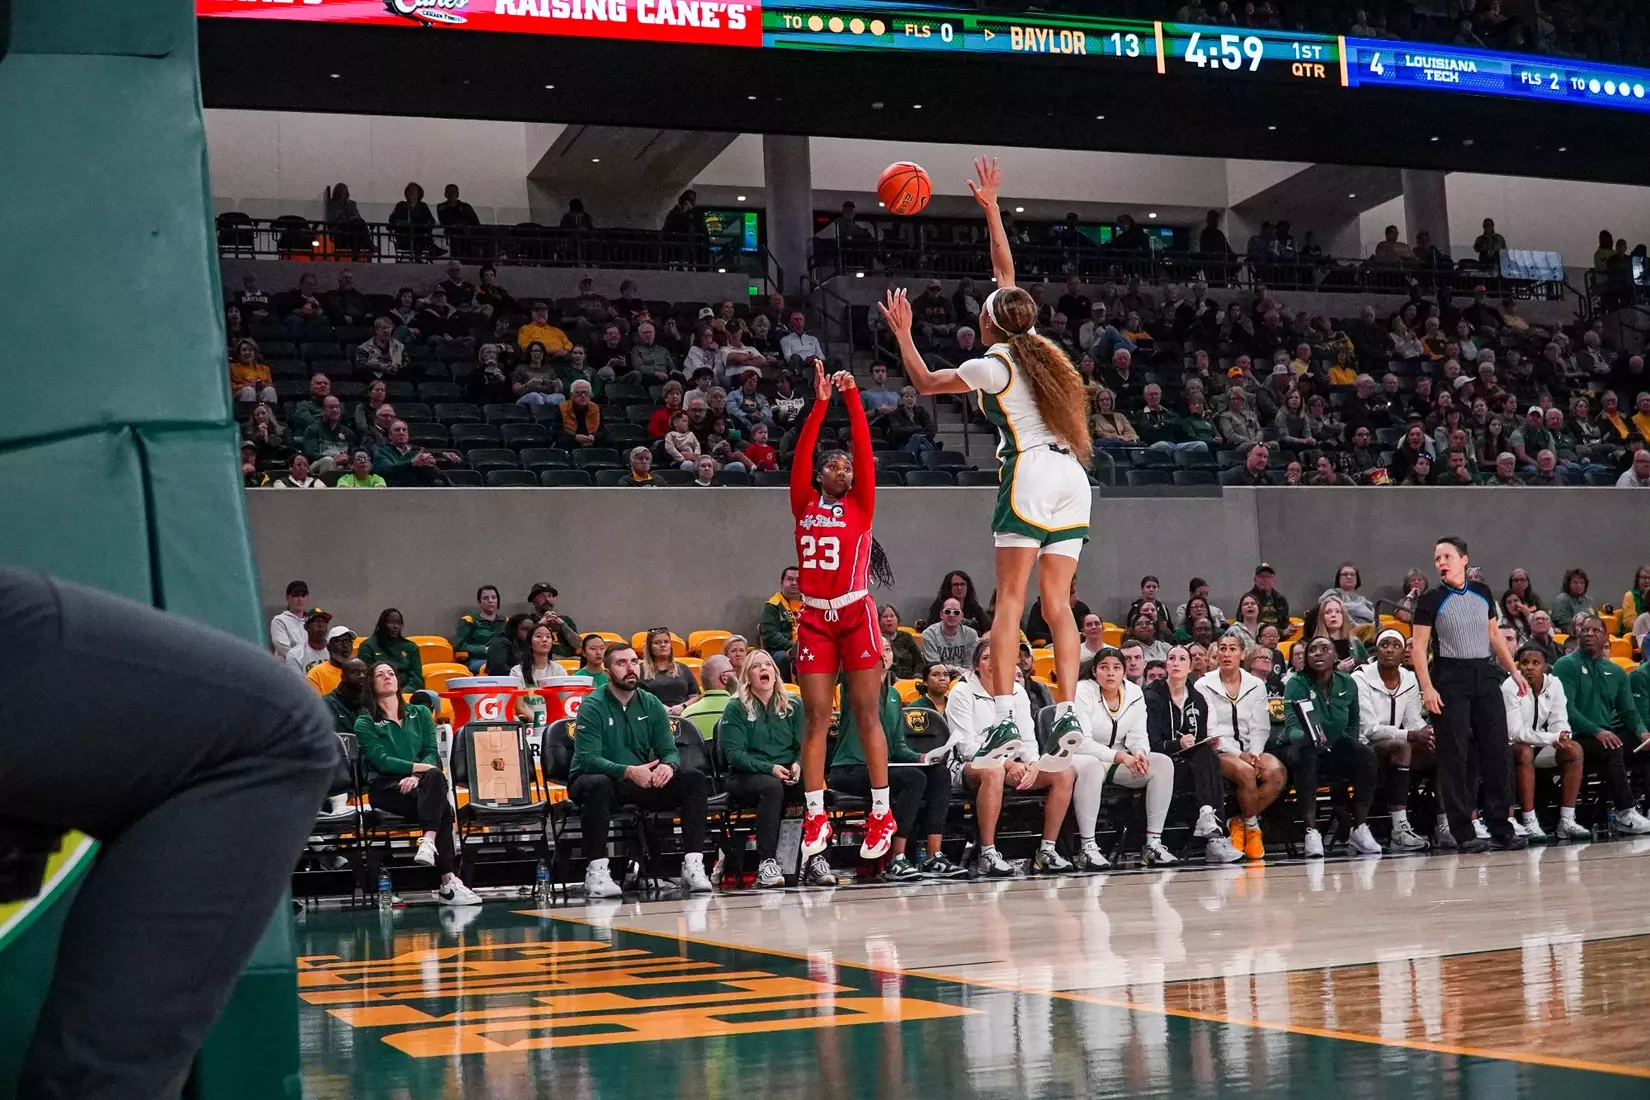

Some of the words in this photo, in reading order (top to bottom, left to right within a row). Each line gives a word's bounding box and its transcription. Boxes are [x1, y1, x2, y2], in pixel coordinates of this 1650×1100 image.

[495, 0, 627, 23] RAISING
[636, 1, 747, 30] CANE'S
[783, 14, 803, 29] TO
[904, 23, 932, 38] FLS
[940, 22, 954, 43] 0
[1010, 26, 1087, 55] BAYLOR
[1110, 32, 1140, 58] 13
[1184, 31, 1264, 72] 4:59
[1292, 41, 1322, 60] 1ST
[1291, 62, 1326, 79] QTR
[1370, 52, 1384, 75] 4
[1405, 55, 1477, 73] LOUISIANA
[1423, 69, 1460, 83] TECH
[1521, 71, 1542, 86] FLS
[1549, 72, 1560, 91] 2
[1570, 77, 1586, 91] TO
[800, 535, 840, 571] 23
[935, 644, 966, 661] BAYOR
[479, 697, 499, 720] G
